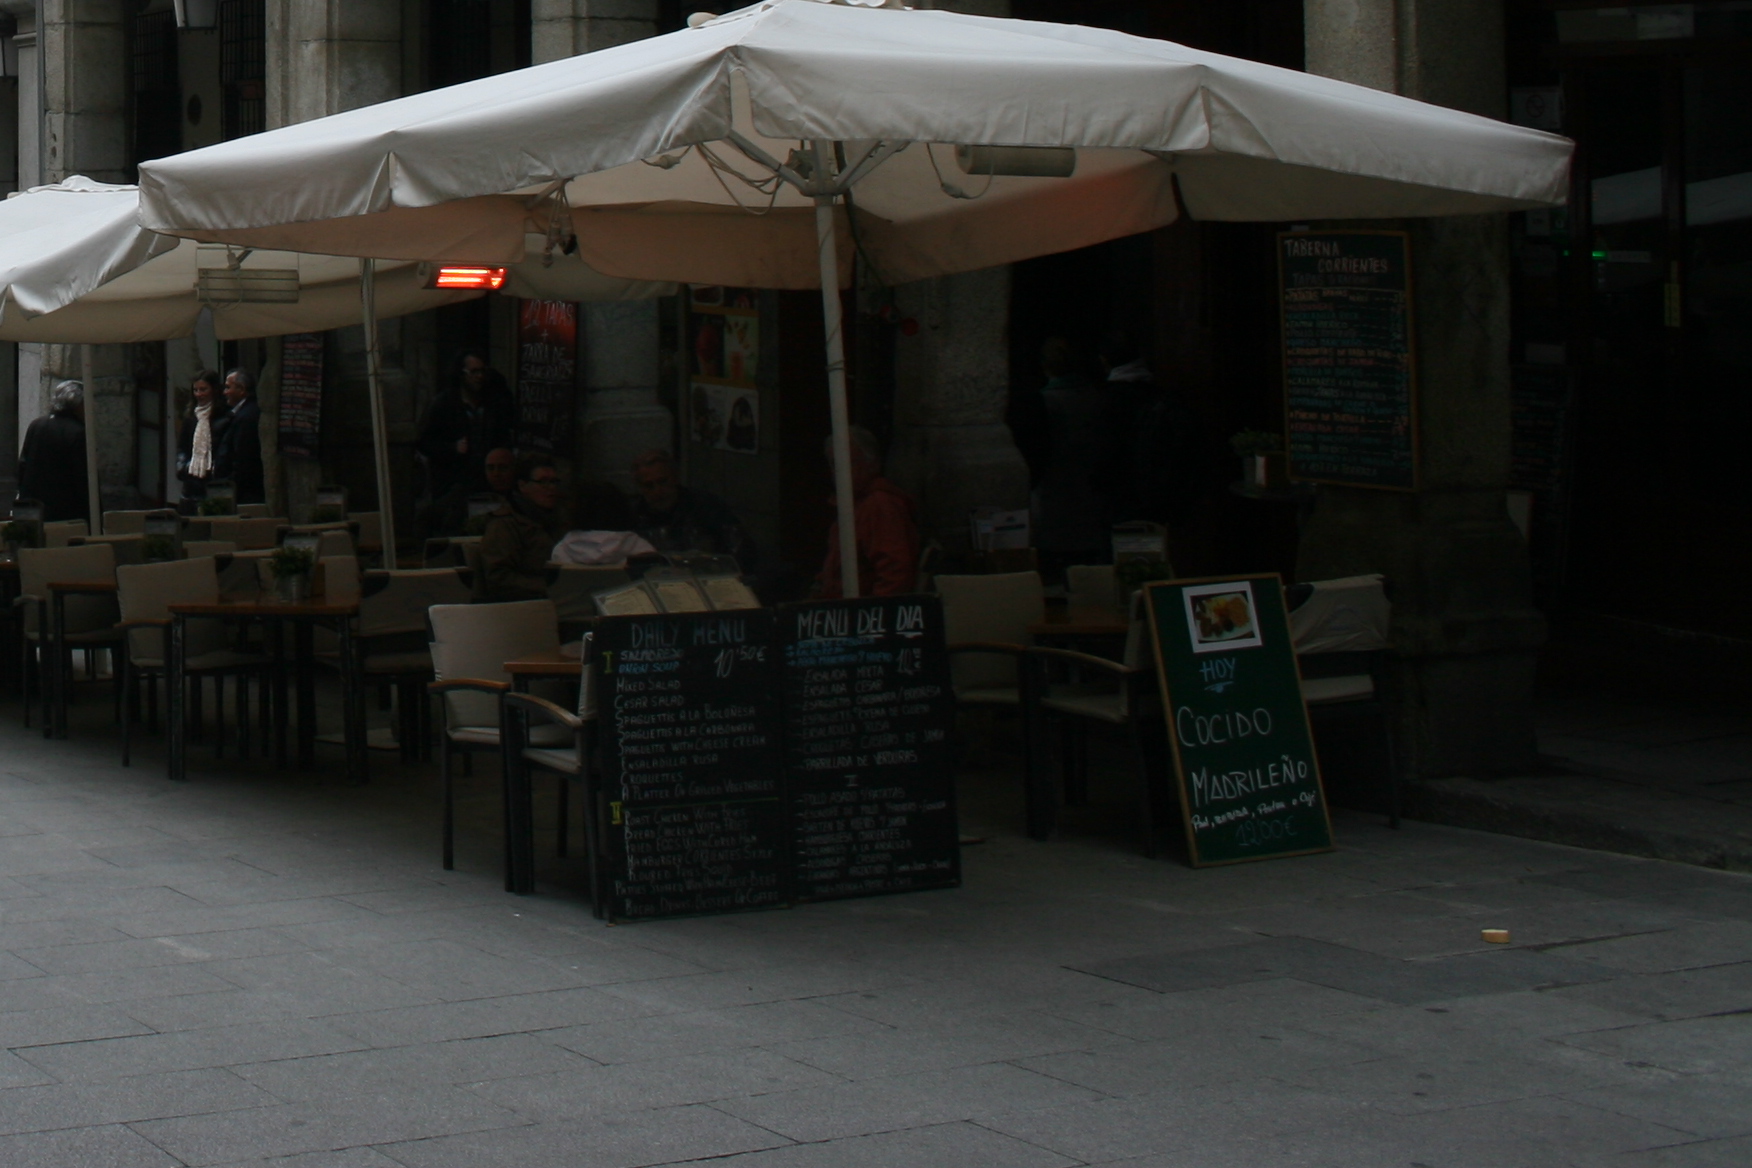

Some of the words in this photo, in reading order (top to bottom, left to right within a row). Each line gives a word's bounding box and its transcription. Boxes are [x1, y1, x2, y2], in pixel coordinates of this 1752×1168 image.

[1284, 238, 1340, 257] TABERNA
[797, 608, 849, 639] MENU
[857, 606, 887, 635] DEL
[896, 605, 924, 632] DIA
[631, 620, 681, 648] DAILY
[693, 618, 746, 646] MENU
[652, 661, 680, 673] SOUP
[1199, 657, 1236, 683] HOY
[648, 678, 681, 690] SALAD
[651, 695, 684, 707] SALAD
[688, 709, 700, 720] LA
[1177, 705, 1272, 748] COCIDO
[856, 755, 868, 767] DE
[1191, 754, 1308, 808] MADRILEÑO
